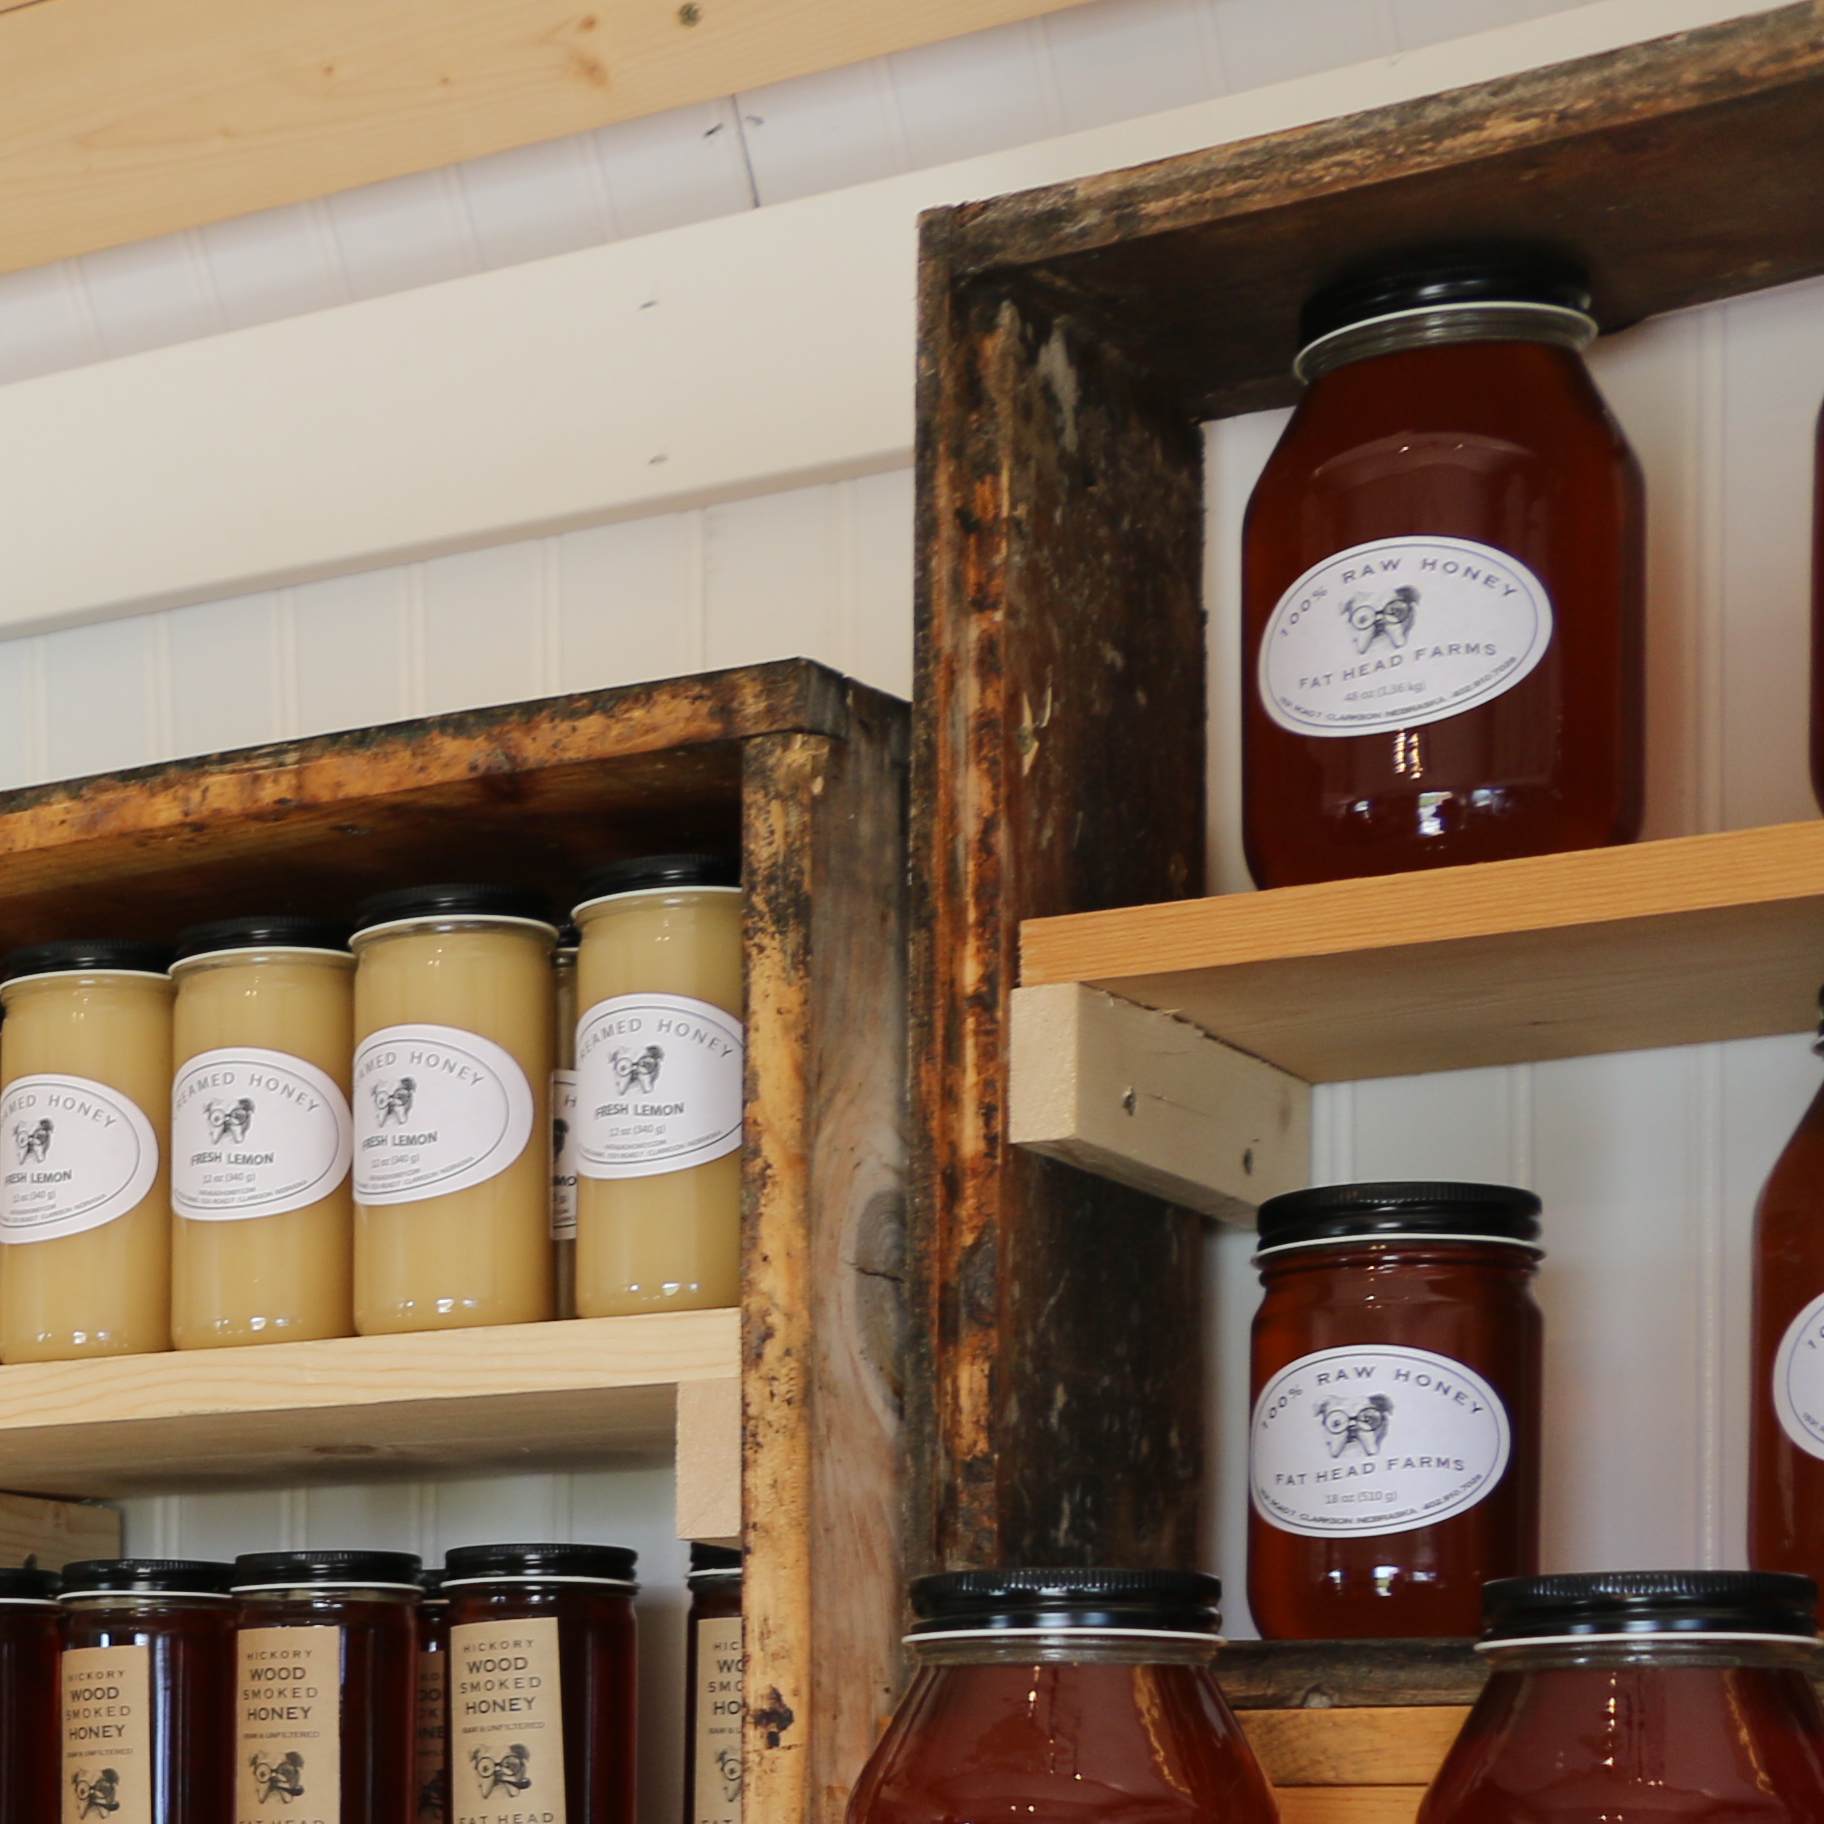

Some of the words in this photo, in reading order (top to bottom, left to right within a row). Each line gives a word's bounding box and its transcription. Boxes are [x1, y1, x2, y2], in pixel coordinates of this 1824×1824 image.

[1342, 558, 1401, 583] RAW
[1421, 558, 1518, 597] HONEY
[1300, 673, 1333, 689] FAT
[1343, 655, 1403, 679] HEAD
[1415, 643, 1497, 660] FARMS
[657, 1018, 733, 1058] HONEY
[249, 1072, 320, 1113] HONEY
[594, 1103, 629, 1120] FRESH
[634, 1102, 685, 1117] LEMON
[191, 1152, 222, 1166] FRESH
[227, 1152, 275, 1166] LEMON
[1317, 1366, 1376, 1386] RAW
[1394, 1368, 1483, 1415] HONEY
[1275, 1473, 1308, 1485] FAT
[1316, 1462, 1376, 1483] HEAD
[1387, 1456, 1465, 1472] FARMS
[463, 1639, 535, 1652] HICKORY
[247, 1650, 313, 1660] HICKORY
[250, 1667, 306, 1681] WOOD
[466, 1656, 529, 1674] WOOD
[243, 1687, 319, 1700] SMOKED
[460, 1676, 542, 1694] SMOKED
[247, 1706, 312, 1721] HONEY
[465, 1696, 537, 1715] HONEY
[498, 1812, 554, 1824] HEAD
